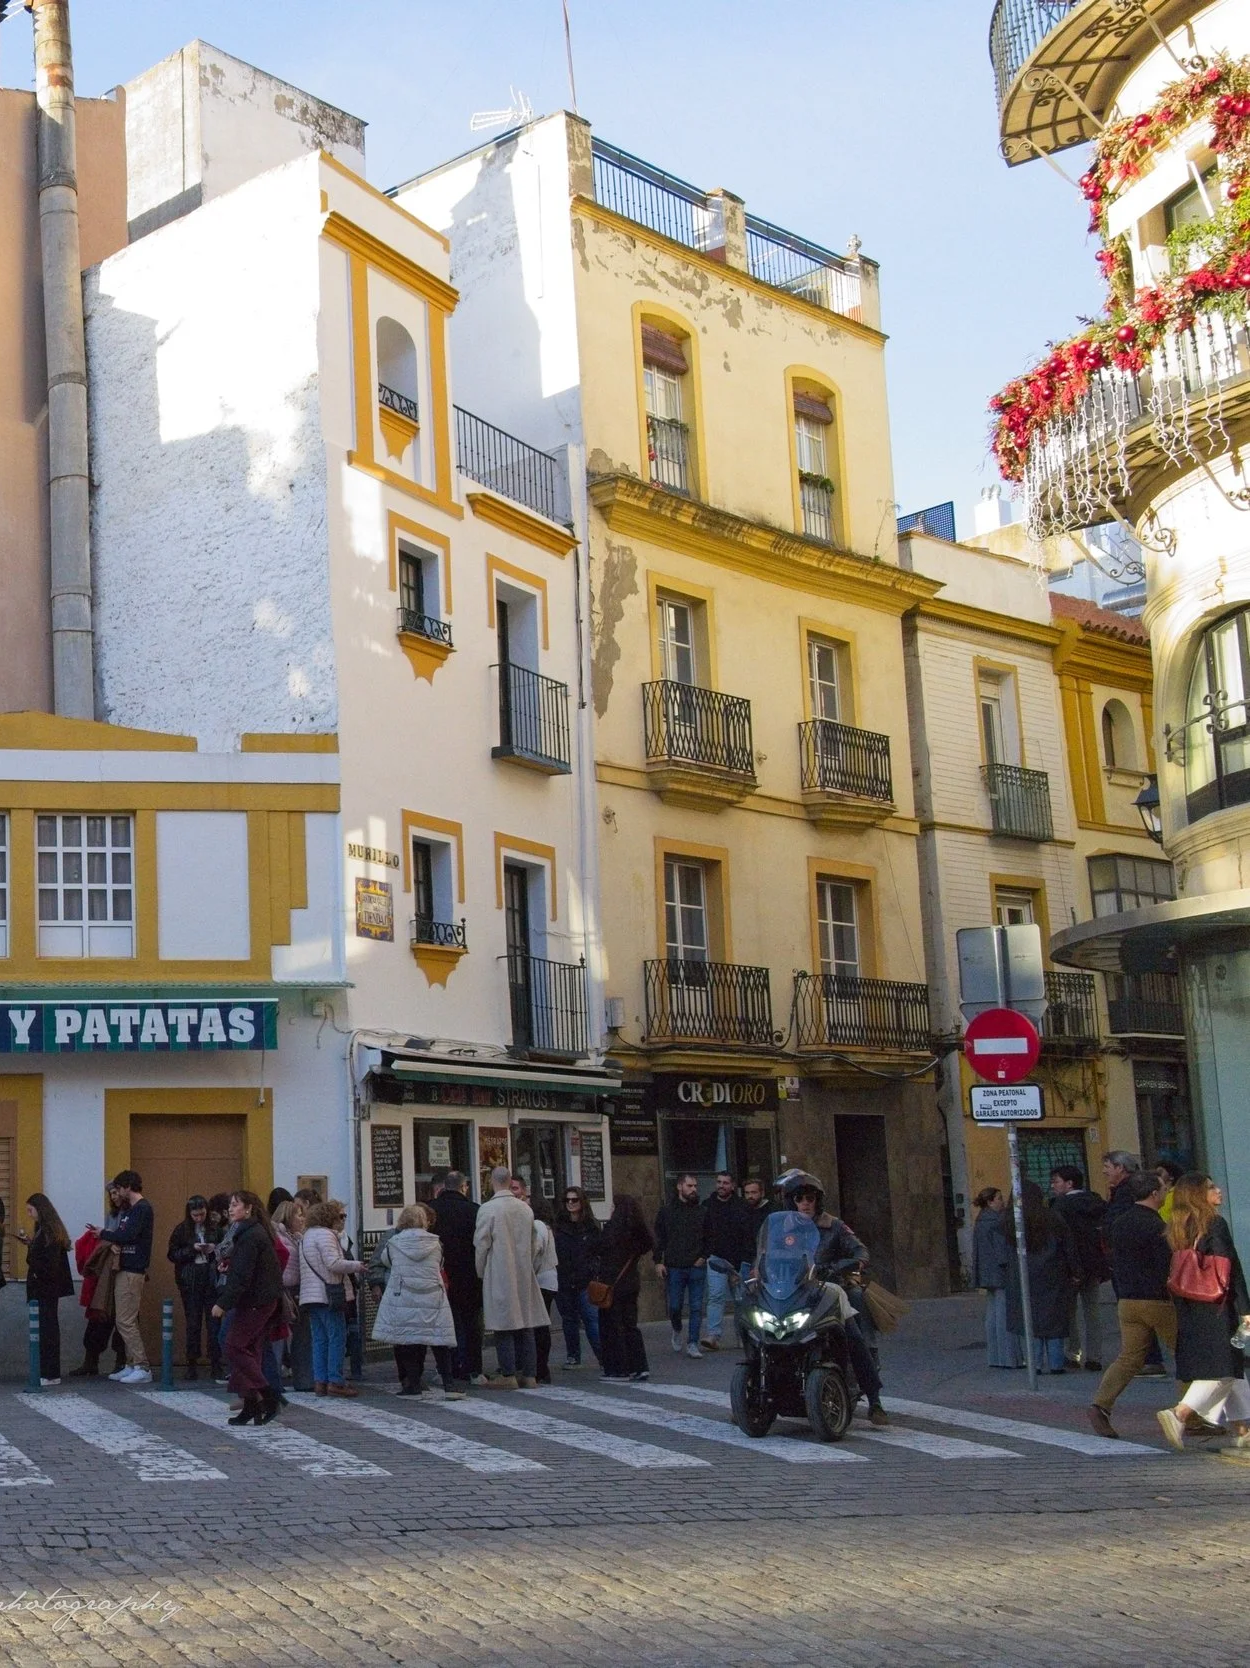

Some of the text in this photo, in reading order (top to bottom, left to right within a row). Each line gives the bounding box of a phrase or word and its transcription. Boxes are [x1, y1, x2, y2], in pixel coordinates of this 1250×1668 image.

[348, 843, 400, 868] MURILLO
[8, 1009, 37, 1044] Y
[54, 1007, 256, 1044] PATATAS
[497, 1087, 548, 1109] STRATOS
[982, 1089, 1027, 1097] ZONA PEATONAL
[993, 1099, 1018, 1107] EXCEPTO
[975, 1109, 1039, 1117] GARAJES AUTORIZADOS
